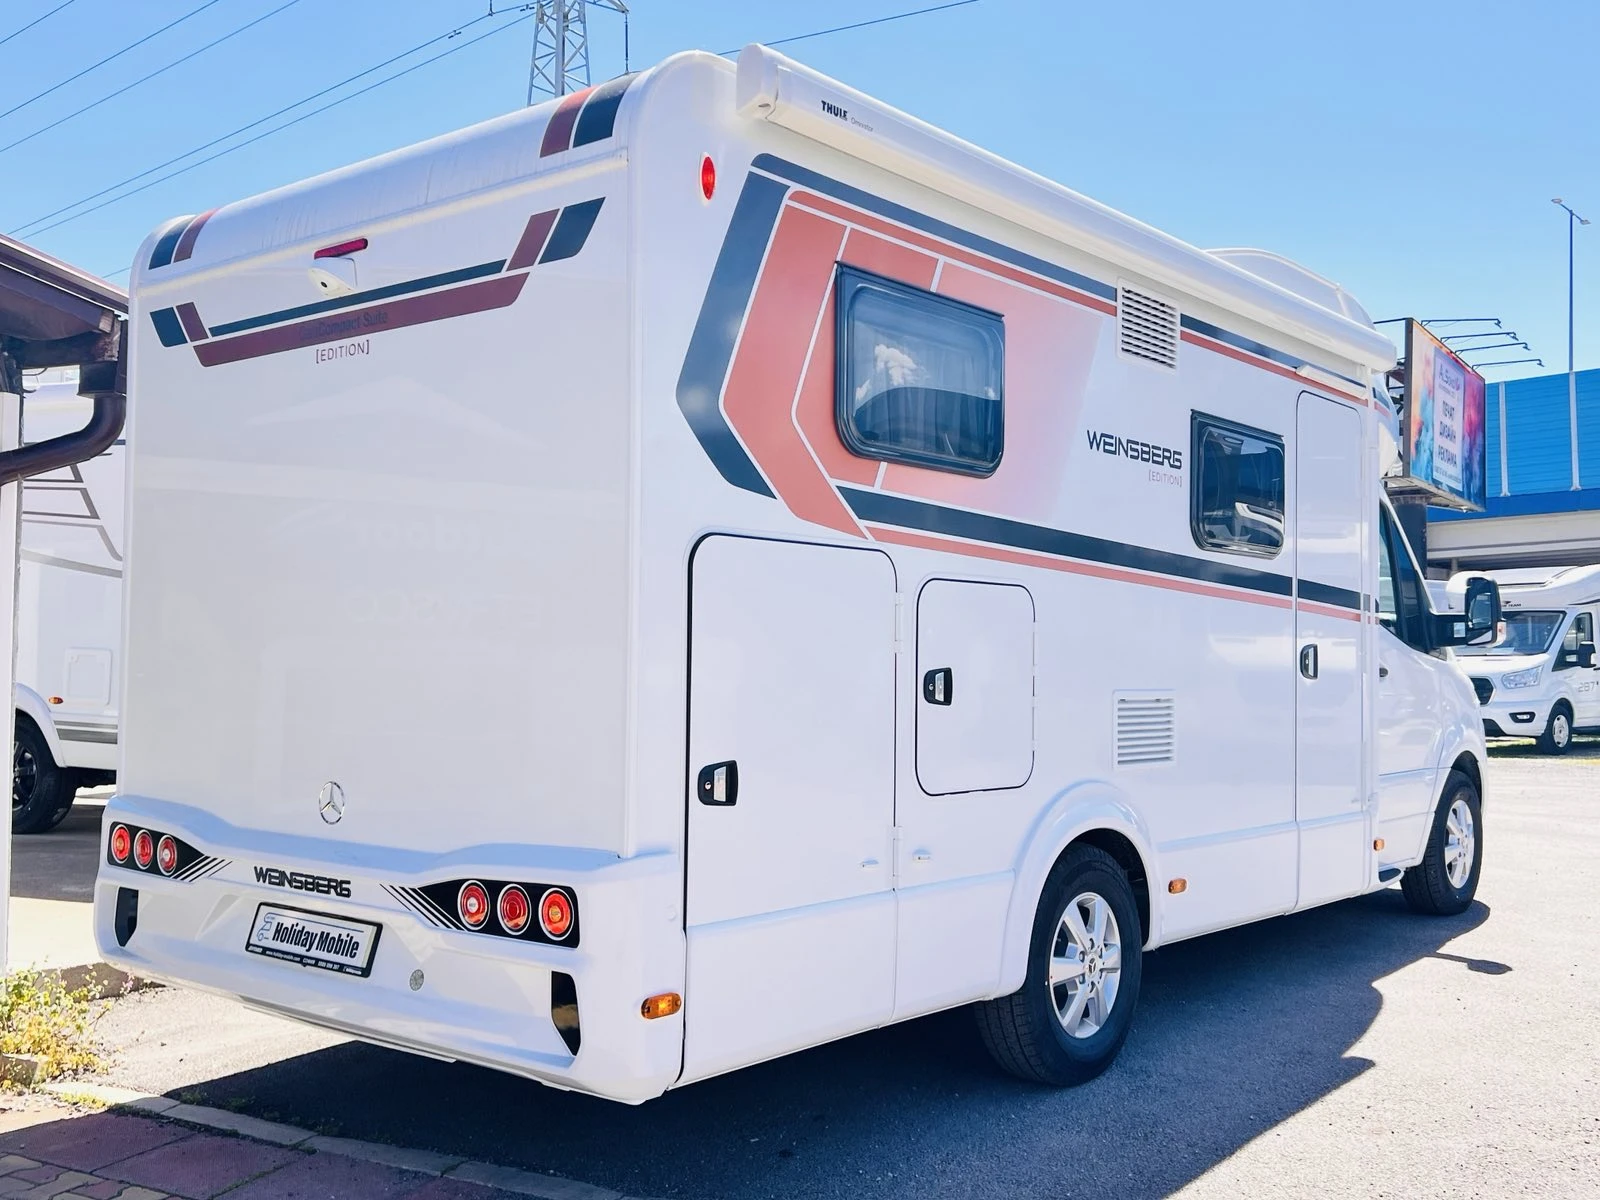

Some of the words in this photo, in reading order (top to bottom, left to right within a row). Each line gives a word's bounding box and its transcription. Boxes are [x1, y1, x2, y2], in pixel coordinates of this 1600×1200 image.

[821, 100, 848, 119] THULE
[363, 311, 389, 327] Suite
[316, 340, 370, 364] [EDITION]
[1086, 430, 1183, 470] WEINSBERG
[1148, 469, 1183, 487] [EDITION]
[254, 866, 352, 898] WEINSBERG
[272, 921, 319, 952] Holiday
[316, 930, 360, 958] Mobile
